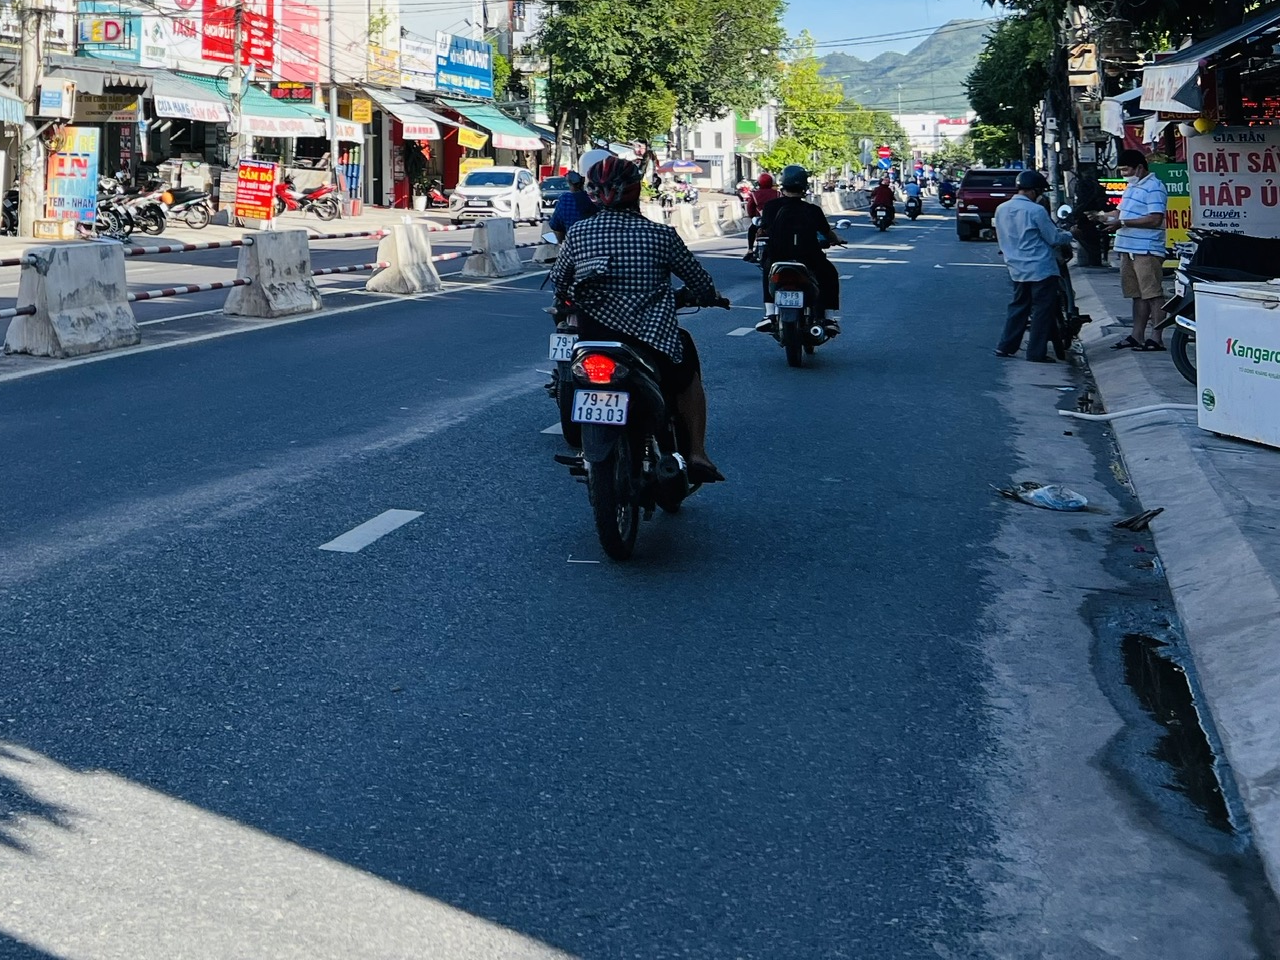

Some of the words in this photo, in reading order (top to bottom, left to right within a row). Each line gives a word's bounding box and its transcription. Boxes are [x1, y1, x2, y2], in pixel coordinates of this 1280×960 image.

[80, 20, 120, 43] LED
[1213, 133, 1233, 142] GIA
[1193, 148, 1241, 176] GIẶT
[1247, 145, 1280, 173] SẤ
[1198, 179, 1252, 207] HẤP
[1261, 178, 1280, 207] Ủ
[49, 197, 65, 207] TEM
[1202, 208, 1241, 219] Chuyên
[556, 336, 579, 348] 79-N
[582, 392, 620, 407] 79-Z1
[577, 406, 624, 423] 183.03
